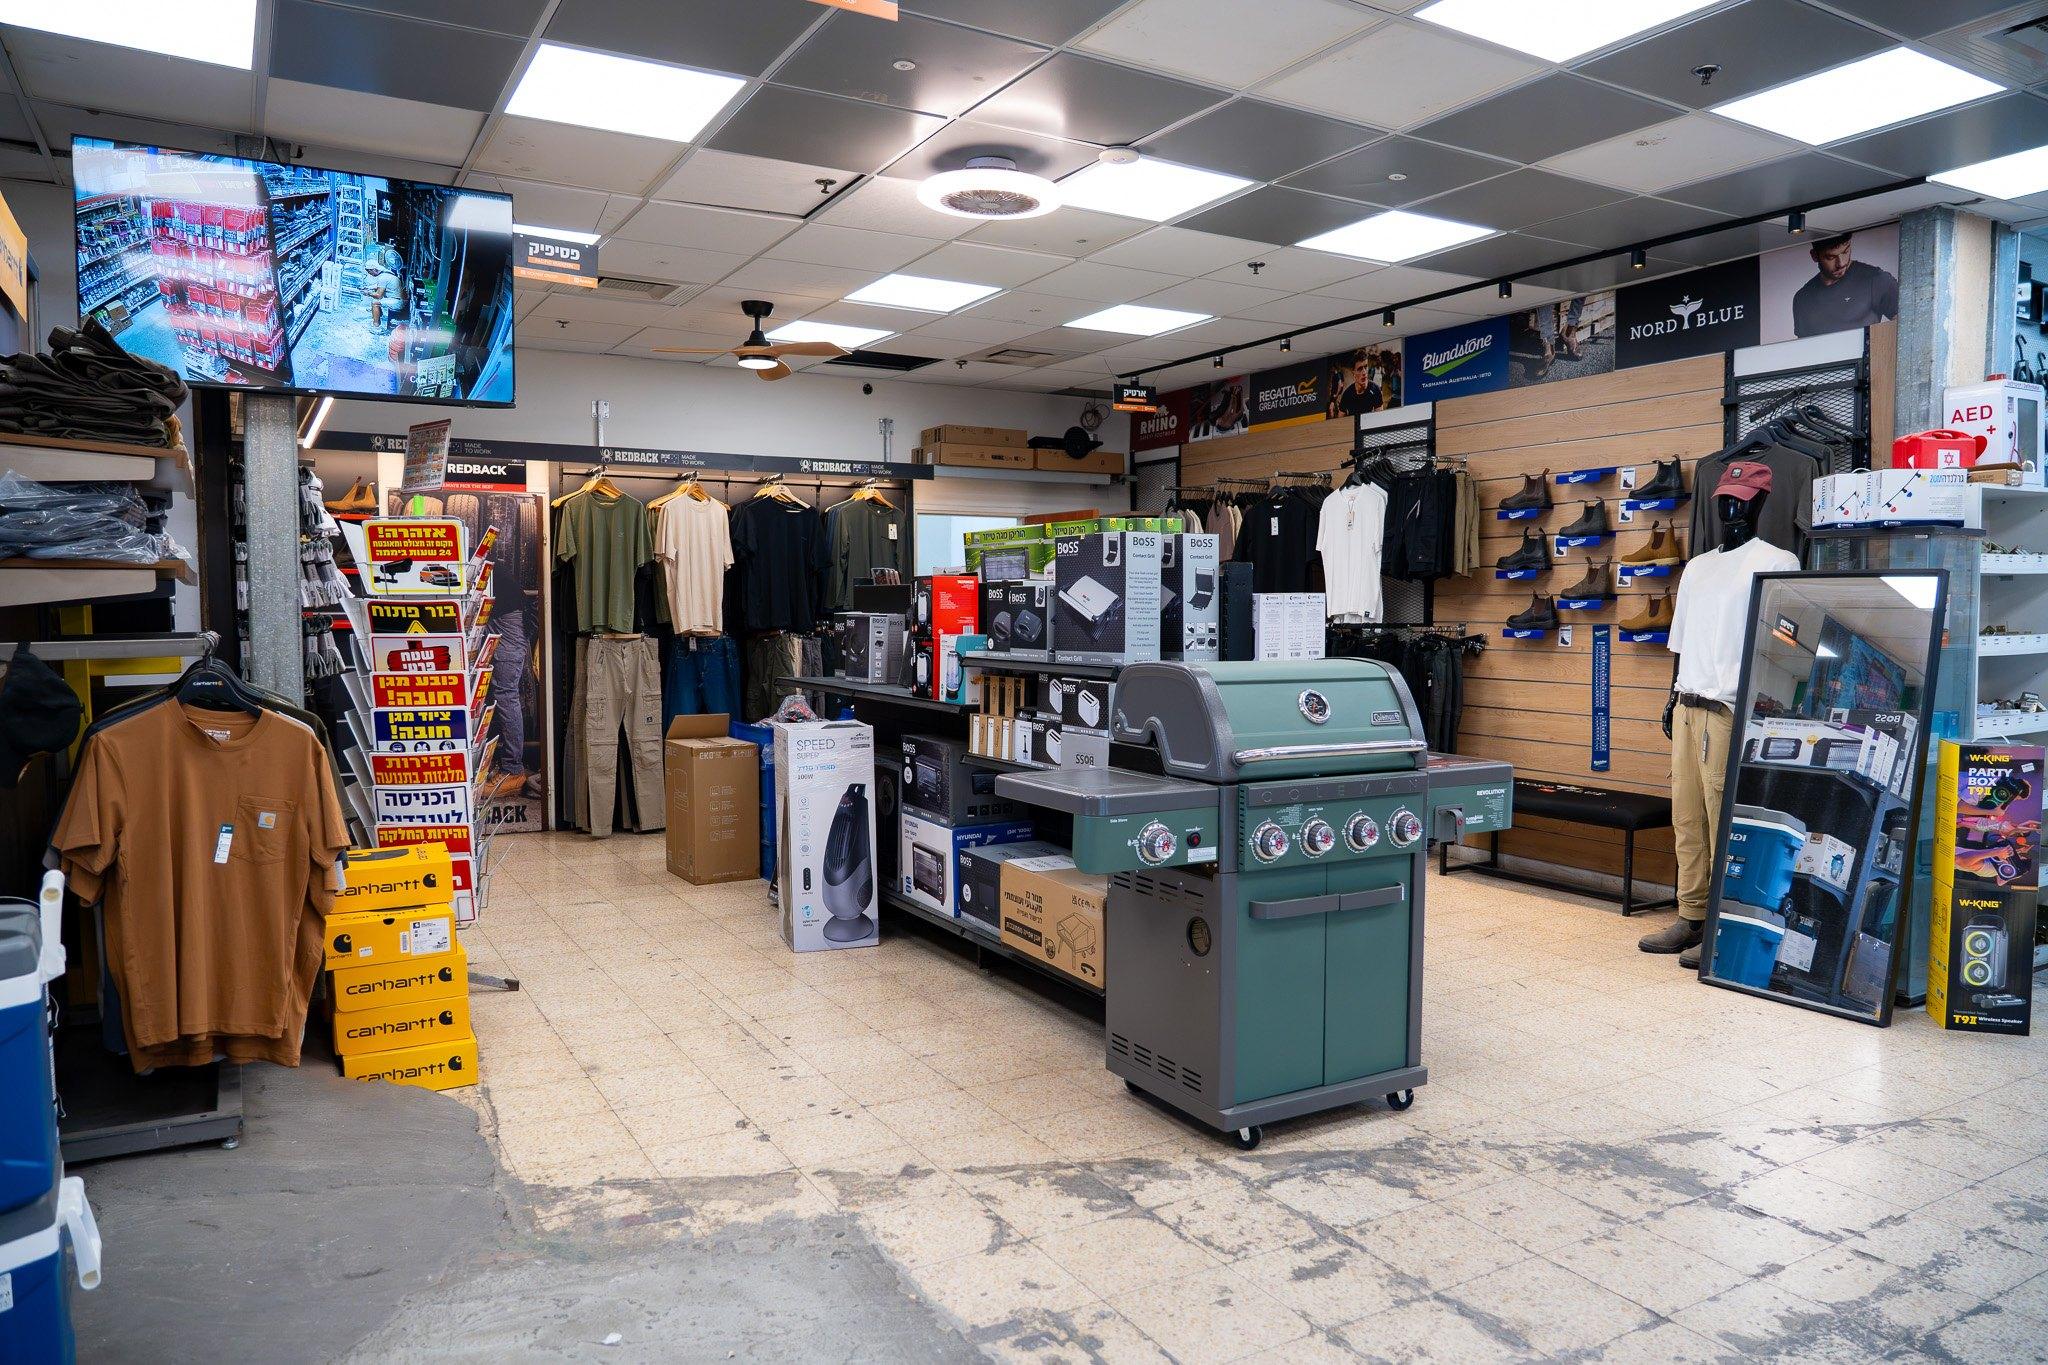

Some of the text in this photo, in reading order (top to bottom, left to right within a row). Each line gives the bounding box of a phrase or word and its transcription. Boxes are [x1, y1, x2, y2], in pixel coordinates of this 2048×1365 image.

[528, 242, 580, 260] פסיפיק
[1630, 305, 1744, 340] NORD BLUE
[1422, 334, 1493, 371] Blundstone
[1422, 380, 1448, 388] TASMANIA
[1123, 388, 1147, 397] ארטיק
[1260, 385, 1297, 402] REGATTA
[1259, 393, 1317, 411] GREAT OUTDOORS
[1951, 405, 1993, 424] AED
[1140, 415, 1178, 434] RHINO
[614, 451, 659, 464] REDBACK
[447, 463, 507, 476] REDBACK
[812, 461, 852, 473] REDBACK
[378, 527, 447, 538] אזהרה!
[373, 540, 402, 548] ומאובטח
[403, 539, 426, 548] מצולם
[436, 540, 454, 548] מקום
[989, 589, 1003, 599] BOSS
[1011, 594, 1026, 603] BOSS
[371, 605, 457, 618] בור פתוח
[400, 650, 434, 661] שטח
[1057, 654, 1073, 662] Contact
[379, 675, 459, 688] כובע מגן
[1063, 684, 1076, 693] BOSS
[387, 690, 454, 706] חובה!
[388, 712, 451, 723] ציוד מגן
[390, 725, 452, 740] חובה!
[1033, 723, 1045, 731] BOSS
[796, 739, 836, 751] SPEED
[902, 742, 916, 753] BOSS
[386, 756, 452, 769] זהירות
[1969, 754, 2010, 765] W-KING
[377, 769, 465, 784] מלגזות בתנועה
[1968, 767, 2013, 778] PARTY
[1968, 777, 1997, 786] BOX
[384, 790, 456, 806] הכניסה
[1477, 788, 1506, 796] REVOLUTION
[378, 828, 468, 842] זהירות החלקה
[956, 832, 982, 841] HYUNDAI
[959, 855, 972, 867] BOSS
[1959, 898, 2000, 910] W-KING
[346, 974, 436, 996] carhartt
[346, 1017, 437, 1039] carhartt
